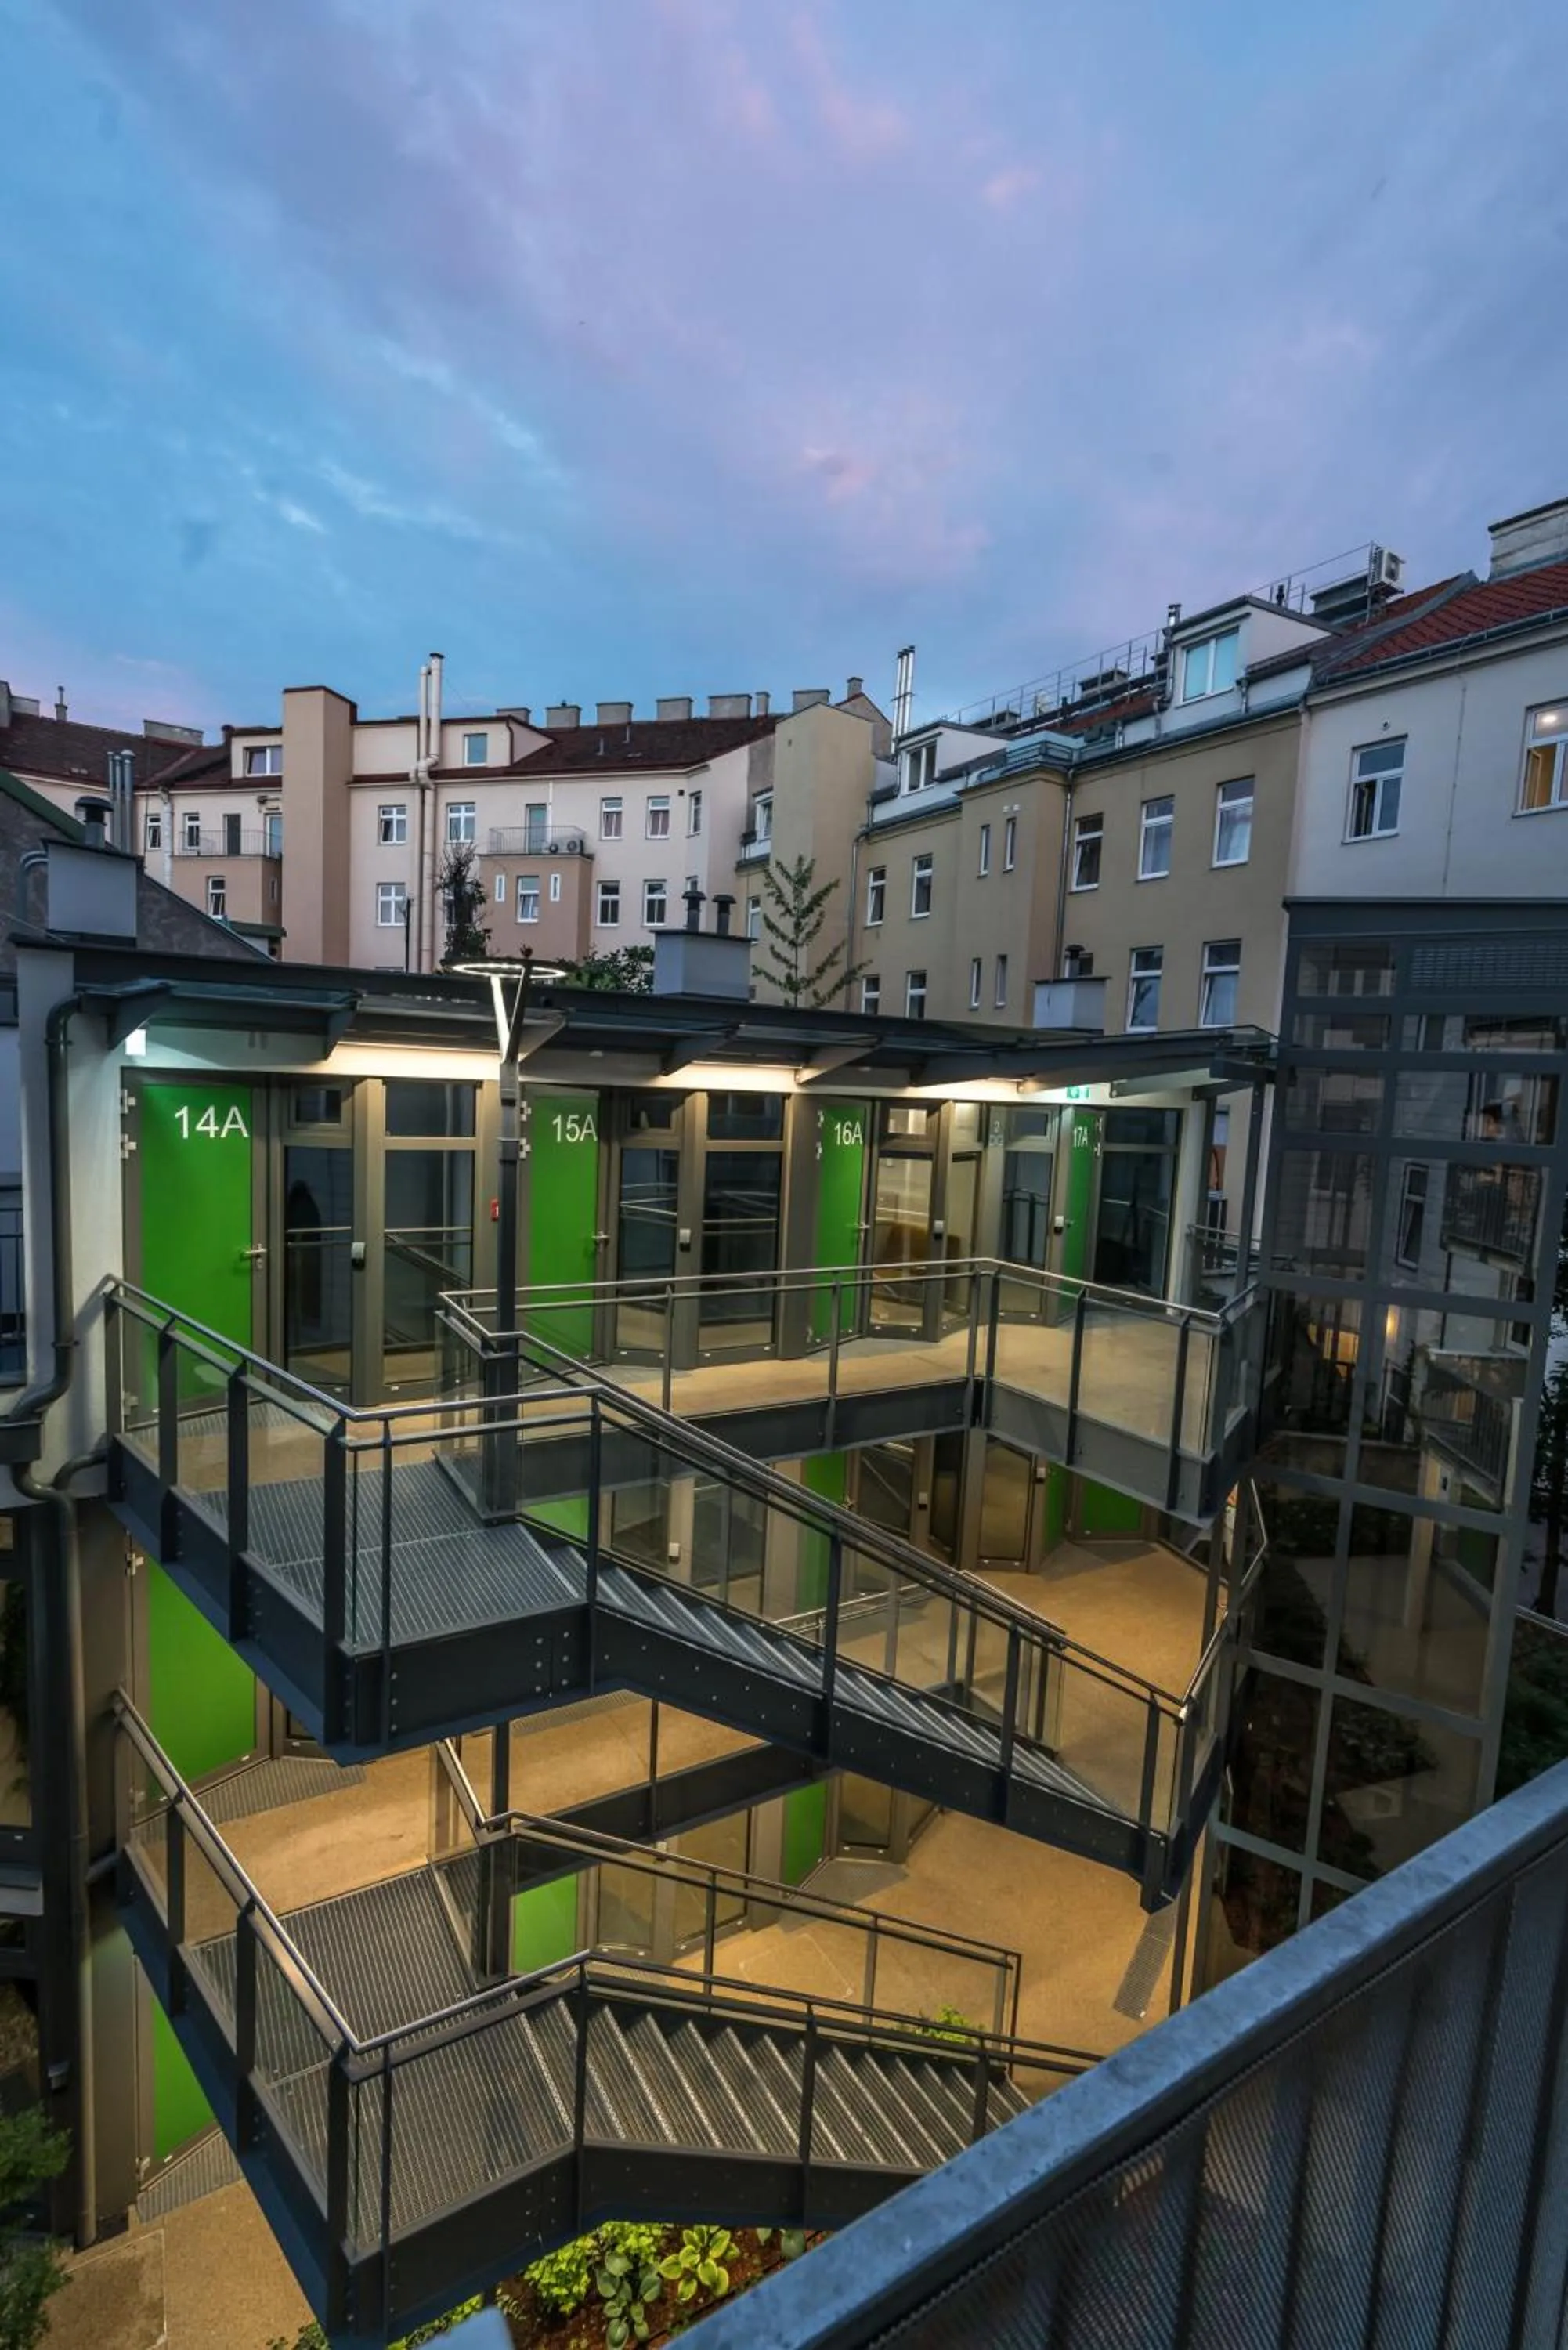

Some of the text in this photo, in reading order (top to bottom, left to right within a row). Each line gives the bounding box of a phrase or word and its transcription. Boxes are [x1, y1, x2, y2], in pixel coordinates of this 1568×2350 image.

[175, 1105, 250, 1139] 14A
[552, 1115, 598, 1142] 15A
[834, 1121, 863, 1145] 16A
[1074, 1126, 1088, 1148] 17A
